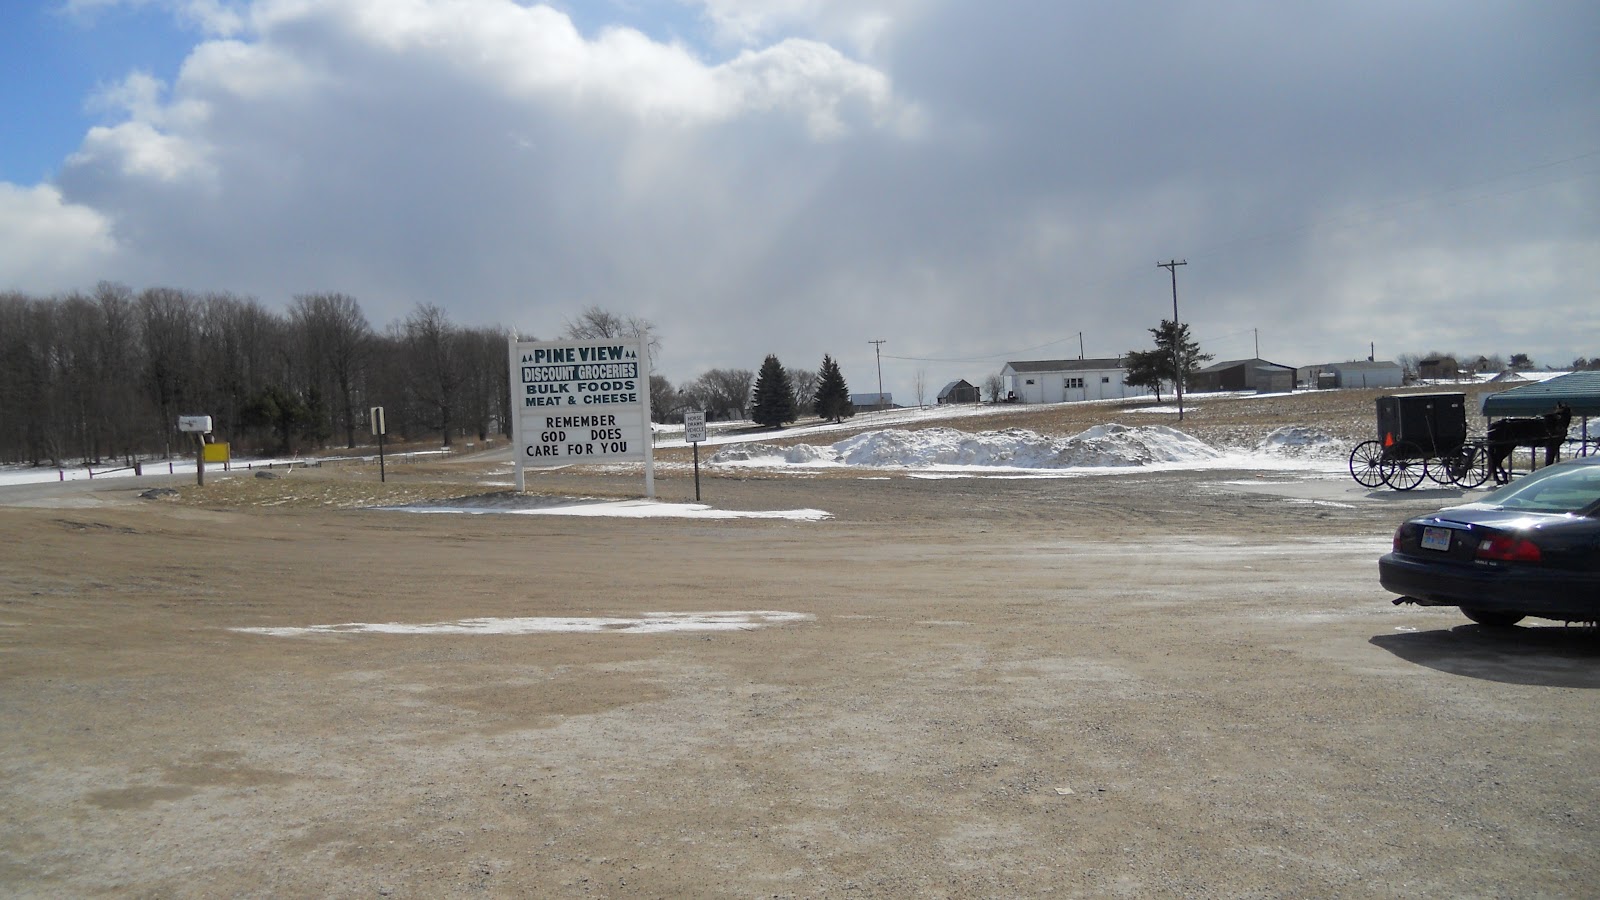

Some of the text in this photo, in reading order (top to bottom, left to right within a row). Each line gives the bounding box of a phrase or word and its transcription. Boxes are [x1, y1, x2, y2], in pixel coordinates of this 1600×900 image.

[534, 346, 624, 363] PINE VIEW
[524, 363, 636, 382] DISCOUNT GROCERIES
[526, 381, 635, 394] BULK FOODS
[525, 393, 637, 407] MEAT & CHEESE
[546, 415, 616, 428] REMEMBER
[541, 428, 622, 443] GOD DOES
[526, 441, 627, 457] CARE FOR YOU
